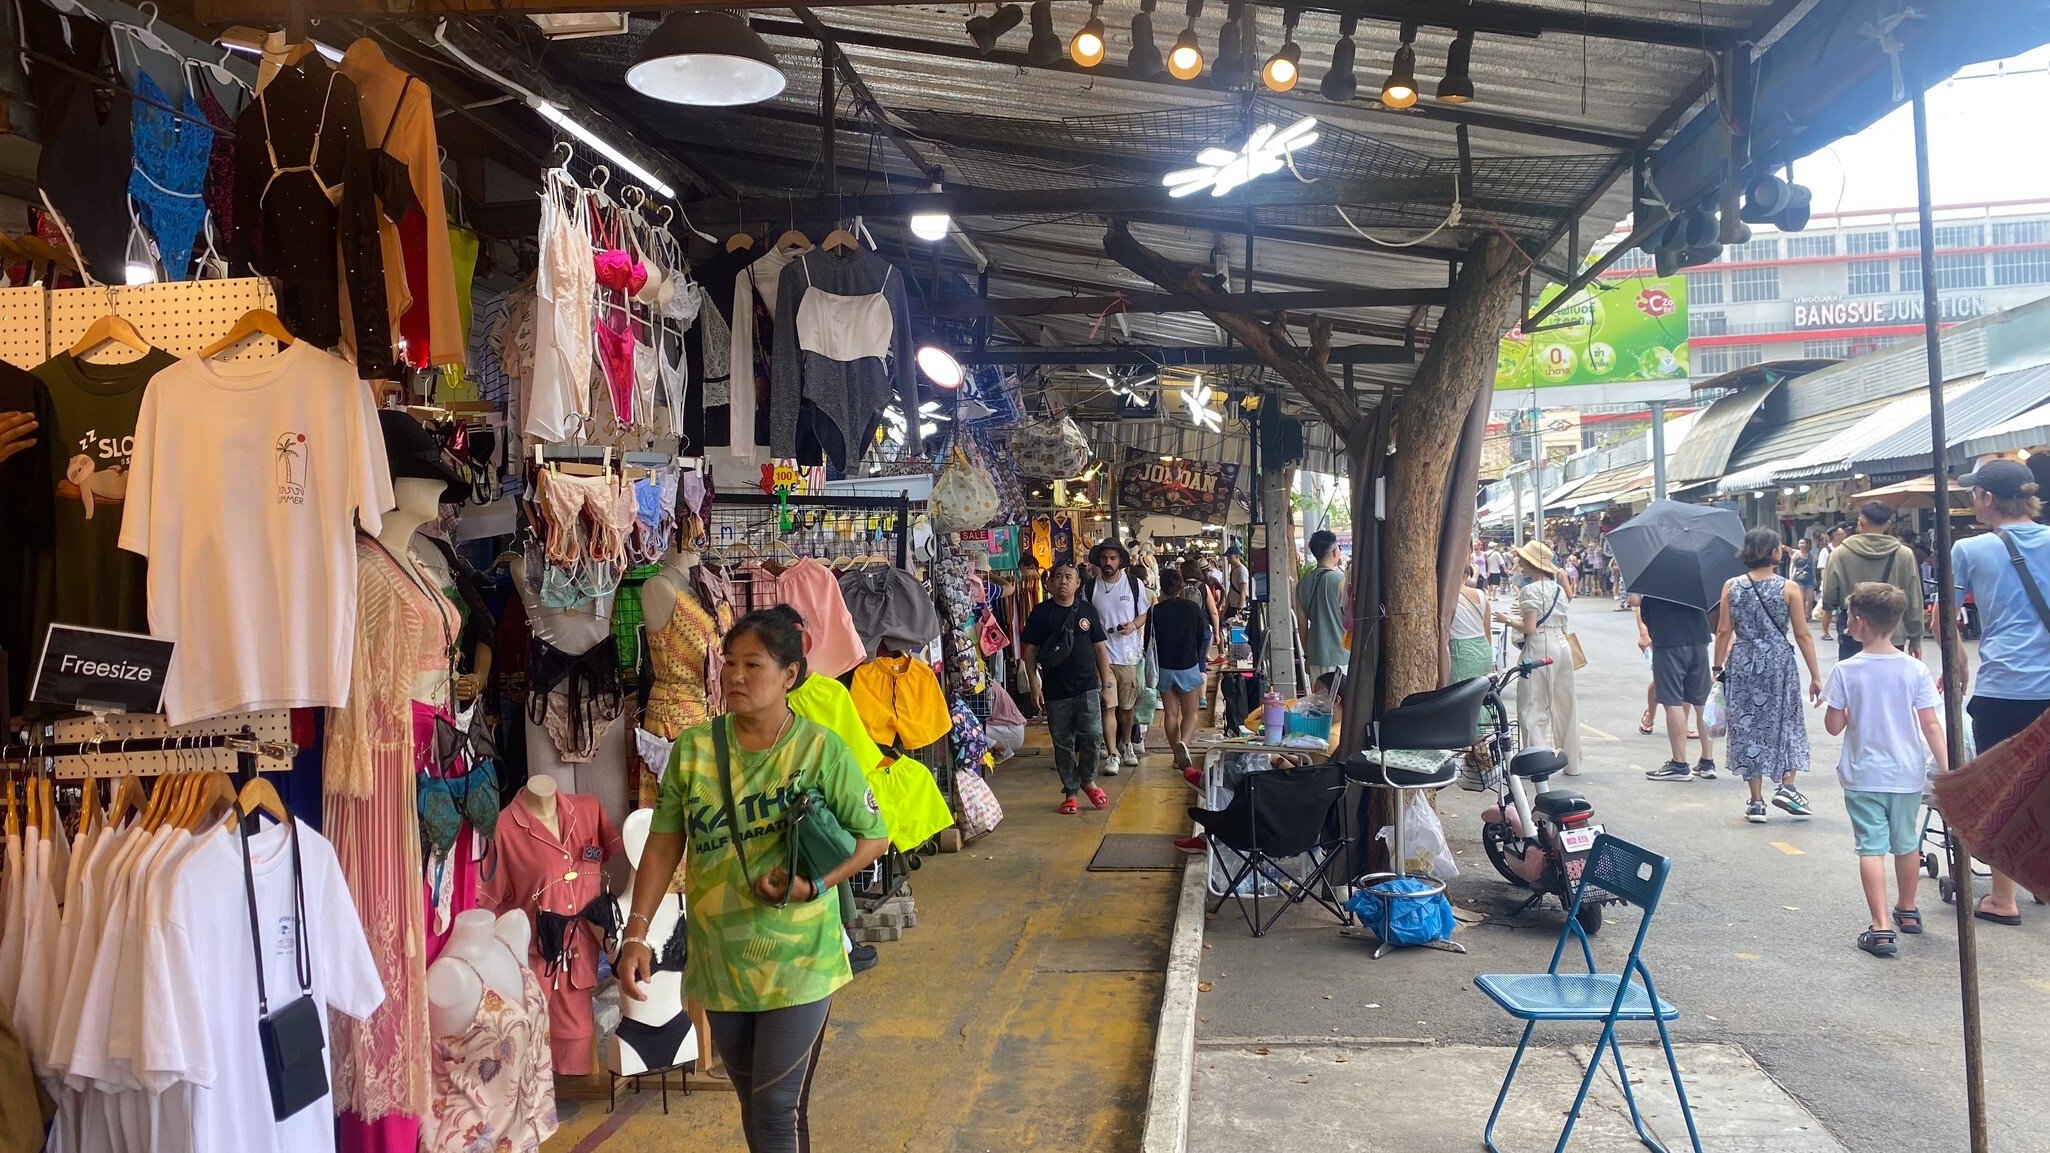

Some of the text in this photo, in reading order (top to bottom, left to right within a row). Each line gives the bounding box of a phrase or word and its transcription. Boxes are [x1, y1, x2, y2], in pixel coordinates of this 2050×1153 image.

[1794, 295, 1985, 327] BANGSUE JUNTION
[98, 435, 135, 459] SLO
[777, 471, 793, 481] 100
[962, 531, 986, 540] SALE
[60, 654, 152, 682] Freesize
[696, 836, 728, 855] HALF
[740, 819, 789, 842] ARAT
